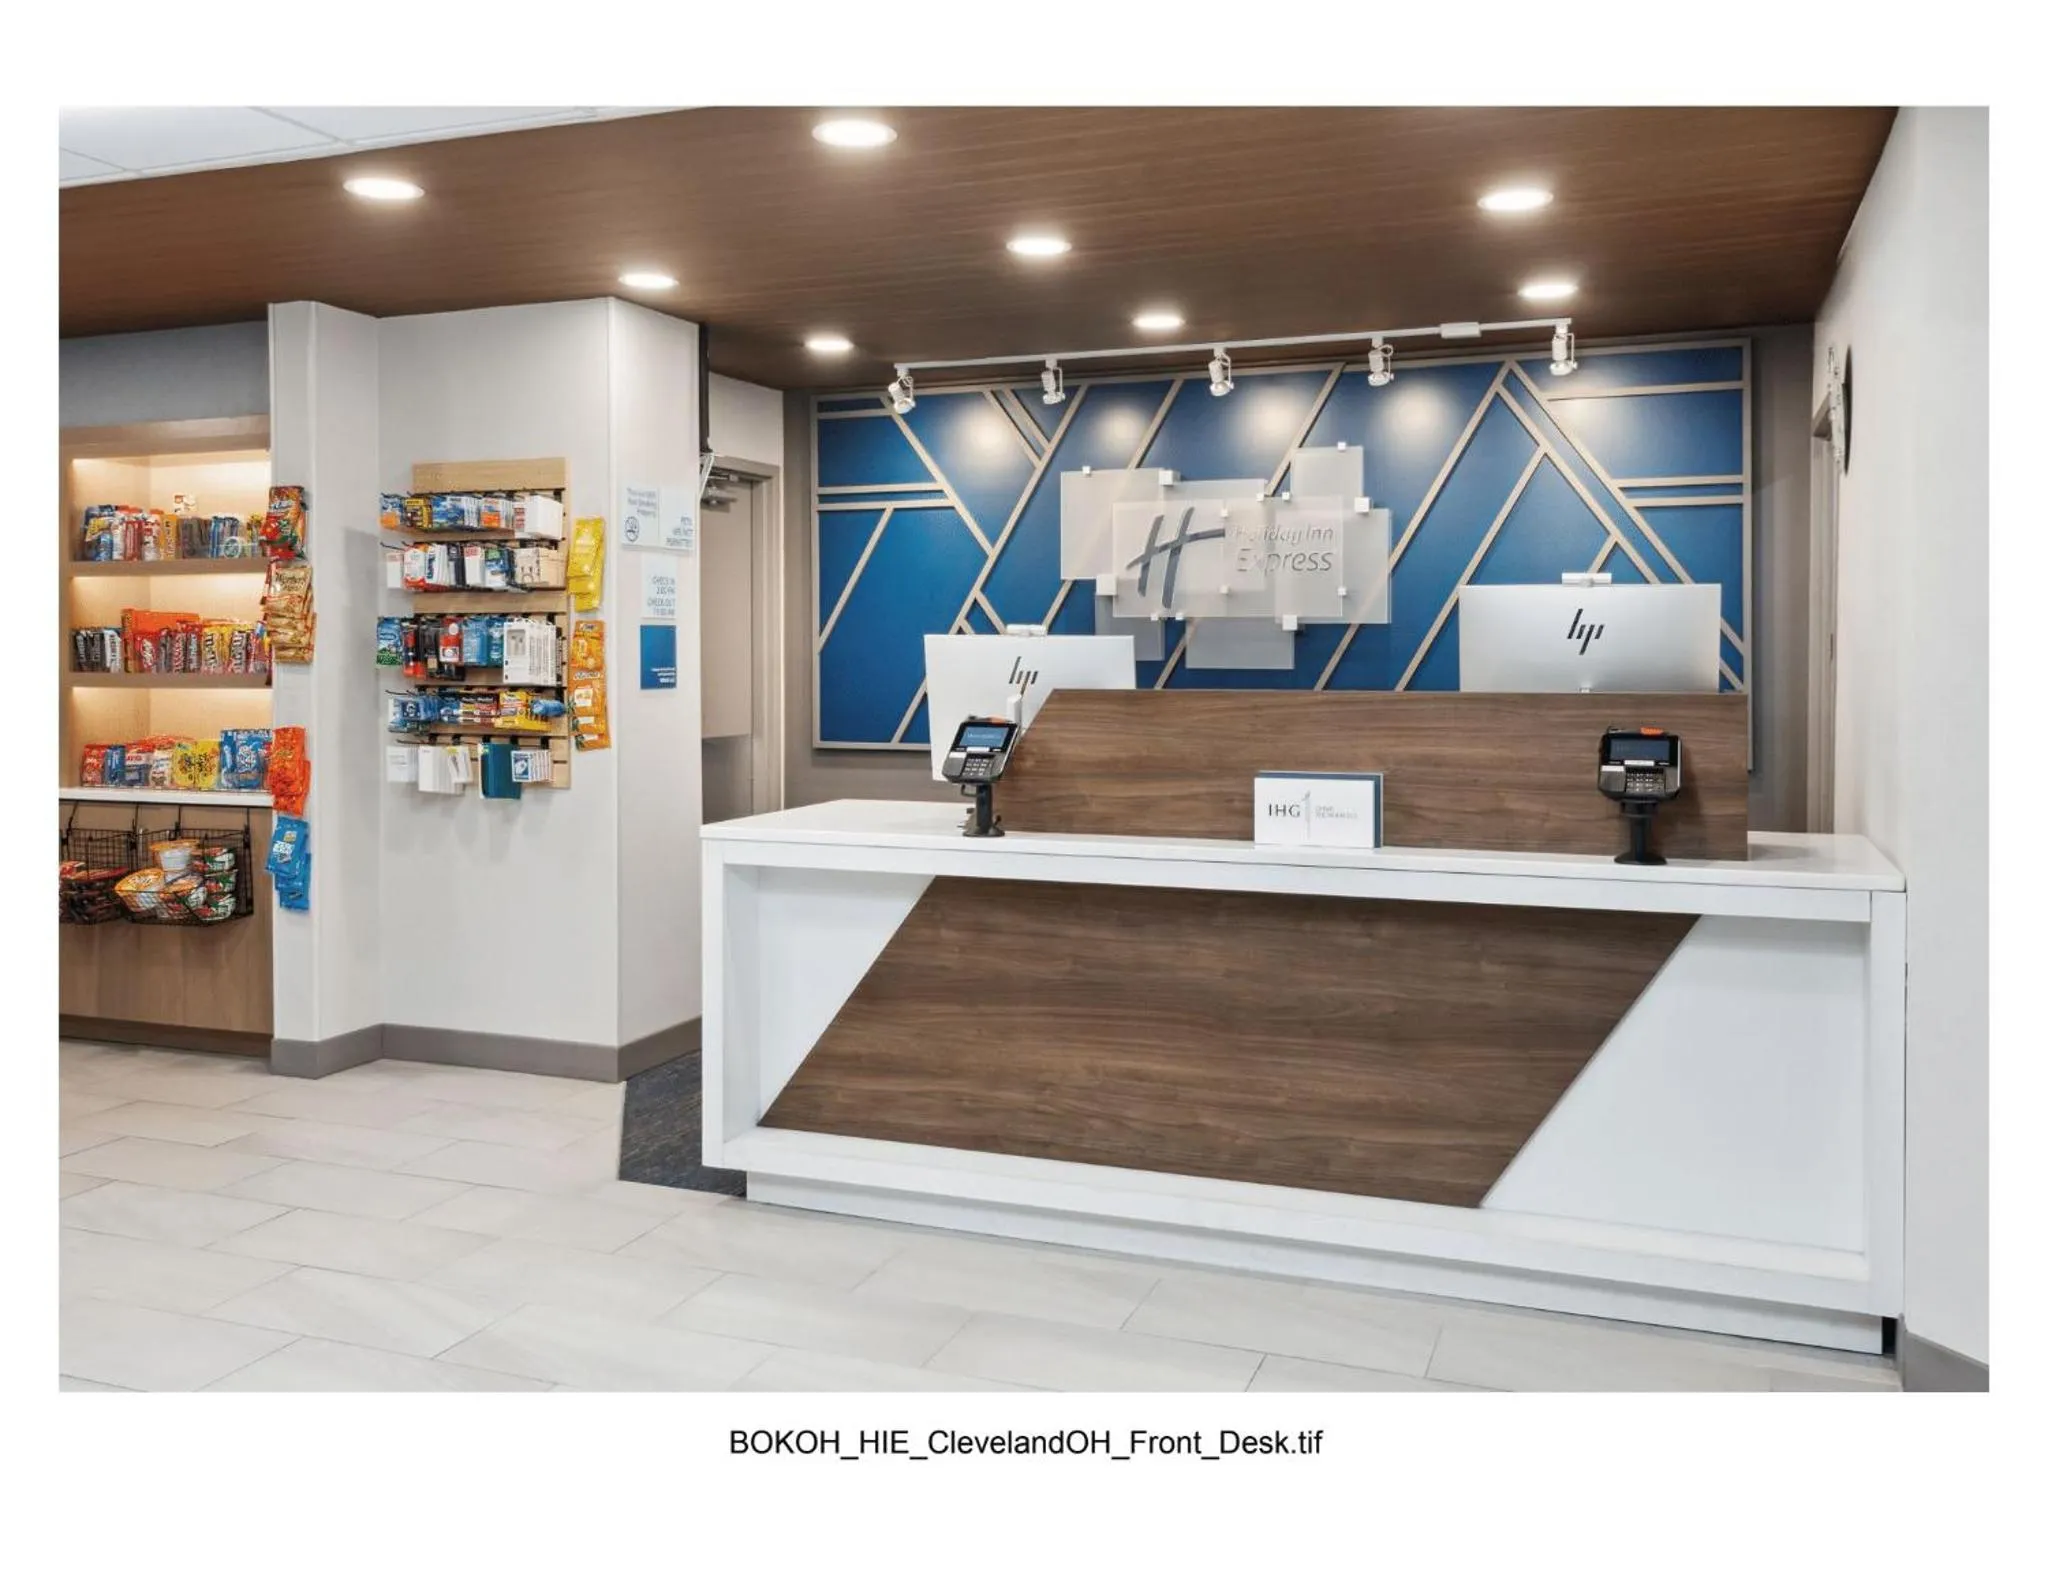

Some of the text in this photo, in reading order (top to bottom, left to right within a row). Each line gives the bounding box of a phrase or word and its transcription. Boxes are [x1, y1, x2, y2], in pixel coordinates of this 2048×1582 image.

[1306, 524, 1334, 541] Inn
[1237, 547, 1334, 576] Express
[1567, 608, 1605, 655] hp
[1268, 803, 1301, 818] IHG
